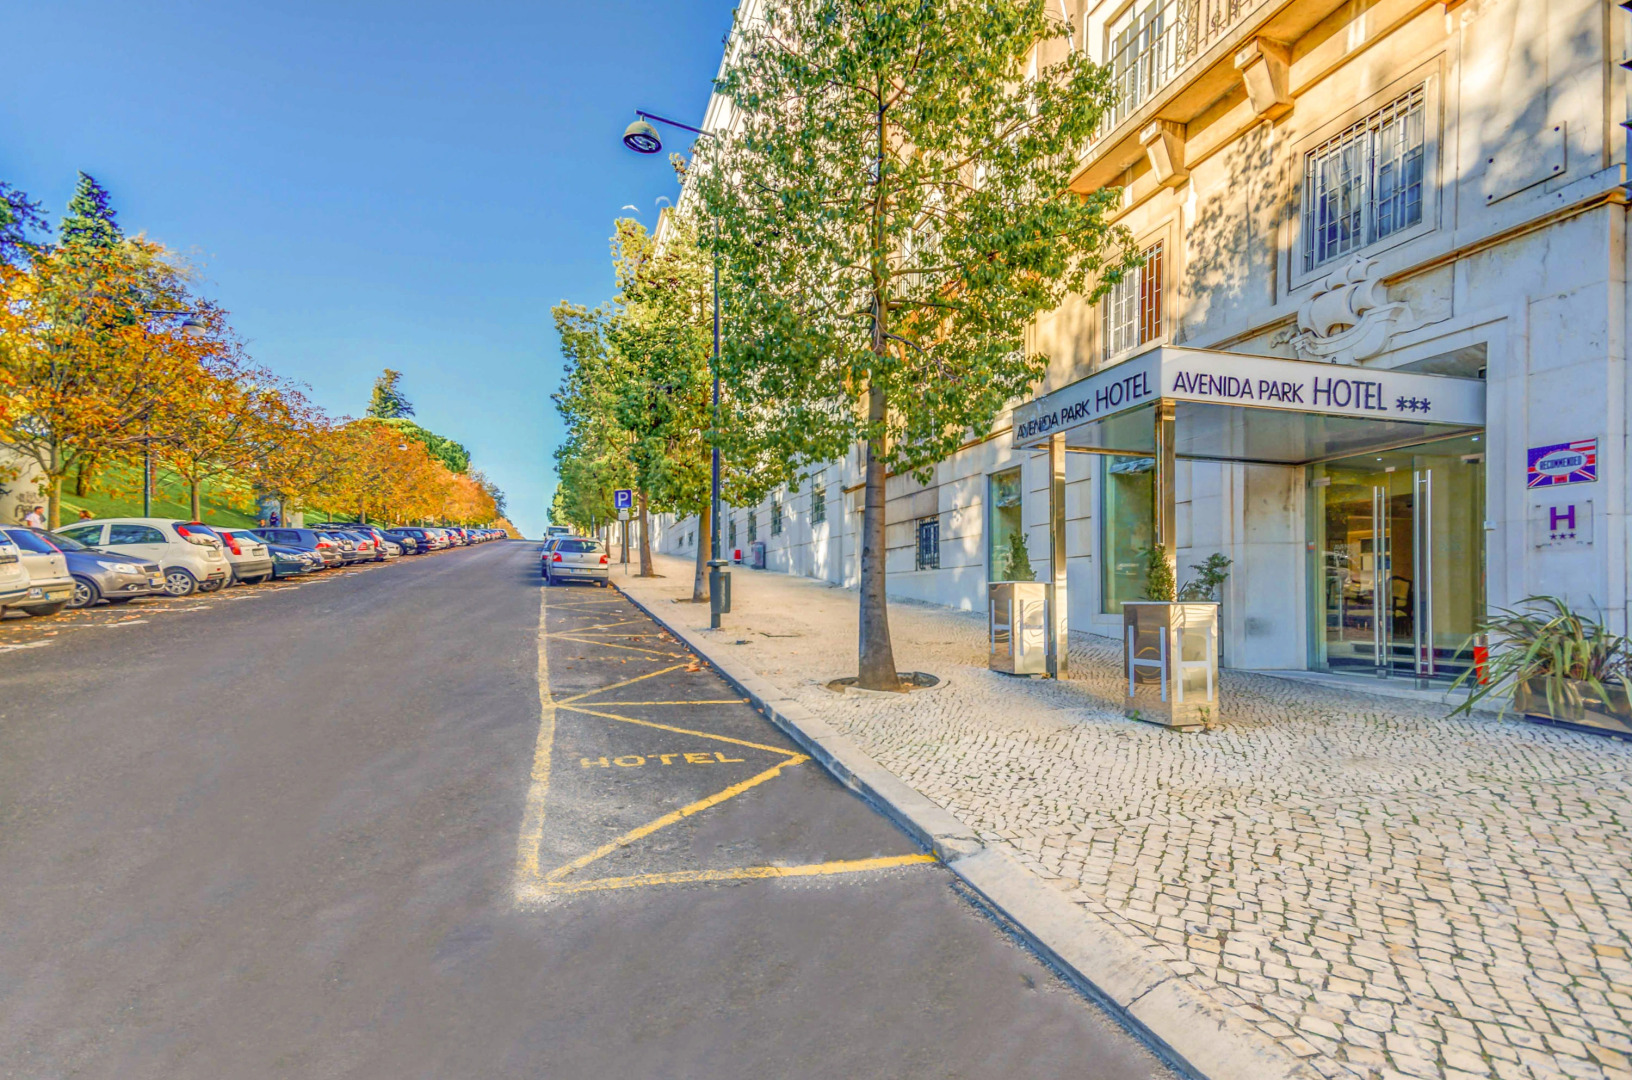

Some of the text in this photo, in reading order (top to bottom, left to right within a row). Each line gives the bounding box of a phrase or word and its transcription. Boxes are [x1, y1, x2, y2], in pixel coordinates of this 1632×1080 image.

[1173, 371, 1388, 411] AVENIDA PARK HOTEL
[1017, 371, 1152, 440] AVENIDA PARK HOTEL
[1539, 456, 1582, 470] RECOMMENDED
[617, 491, 628, 507] P
[1550, 505, 1575, 530] H
[580, 752, 744, 768] HOTEL
